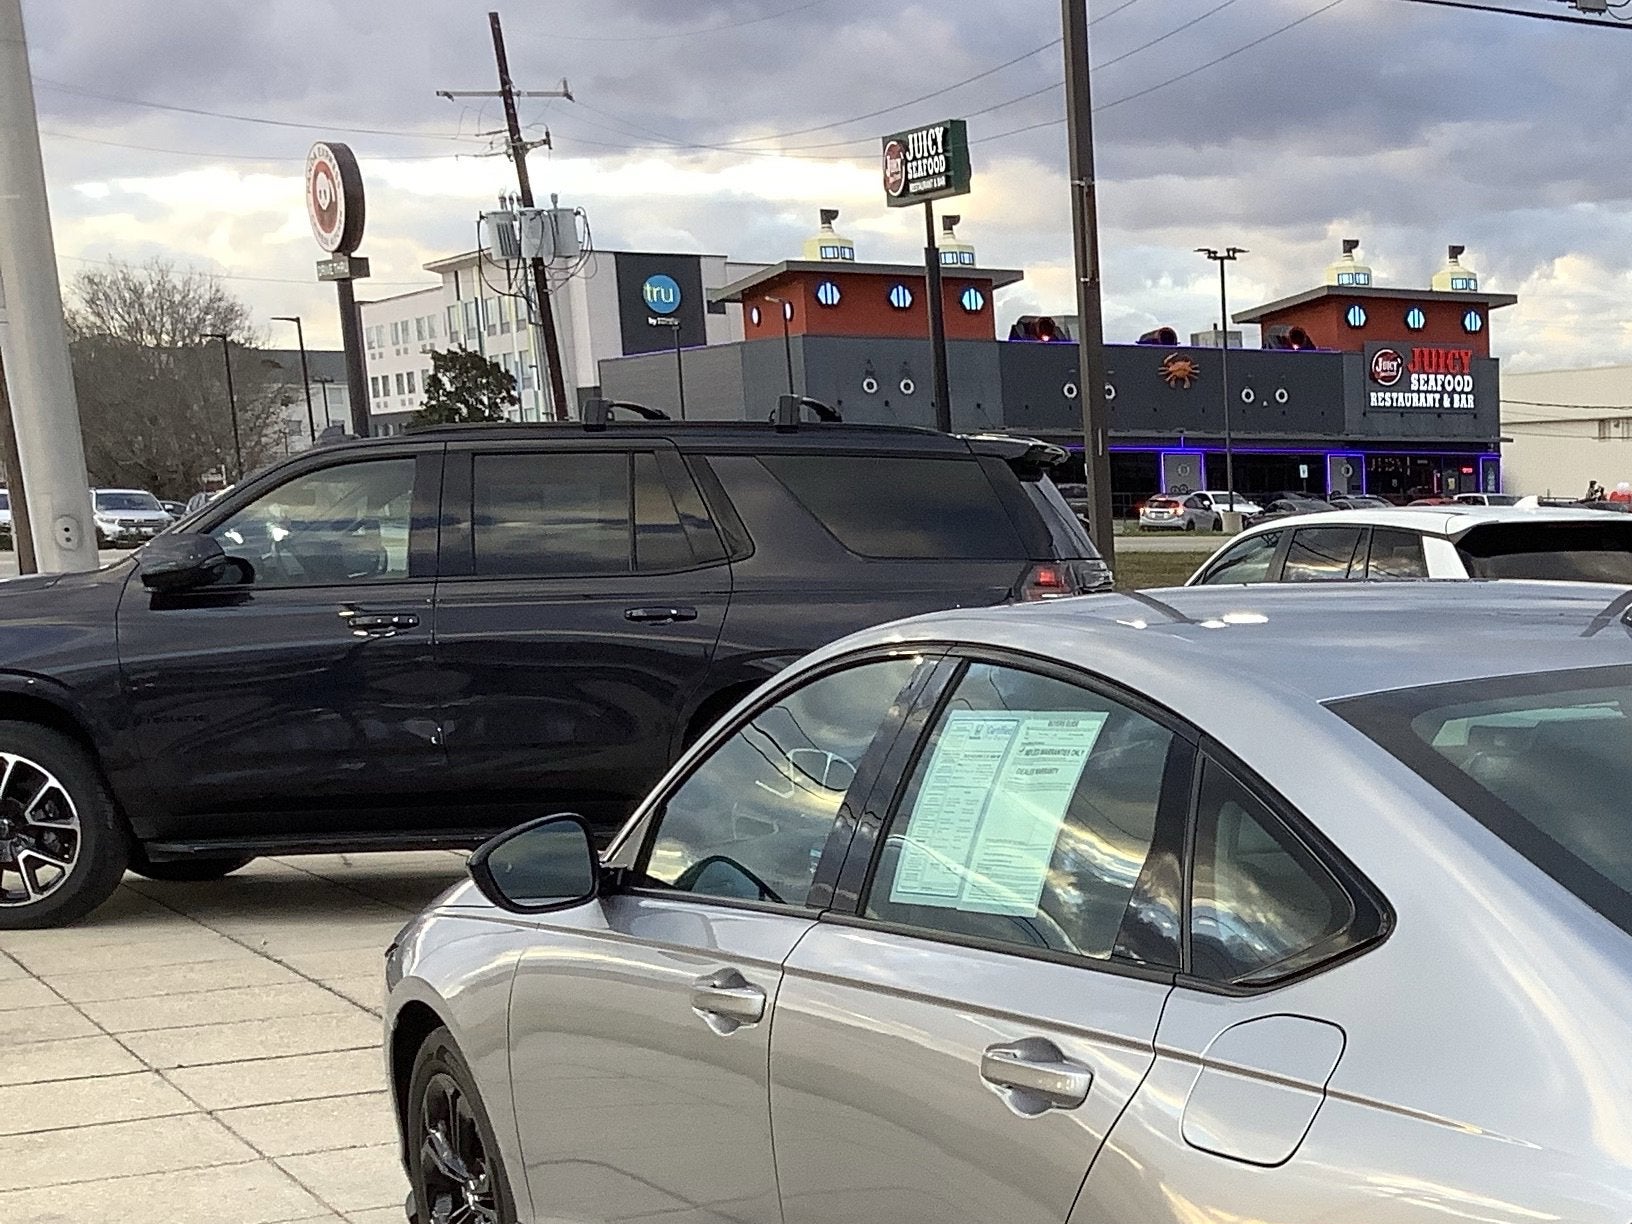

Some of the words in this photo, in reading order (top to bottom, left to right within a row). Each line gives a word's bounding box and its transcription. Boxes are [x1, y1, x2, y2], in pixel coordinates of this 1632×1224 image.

[906, 126, 944, 161] JUICY
[907, 154, 946, 180] SEAFOOD
[643, 282, 674, 302] tru
[1408, 347, 1473, 374] JUICY
[1410, 373, 1473, 392] SEAFOOD
[1370, 392, 1440, 407] RESTAURANT
[1443, 393, 1451, 408] &
[1453, 394, 1475, 408] BAR
